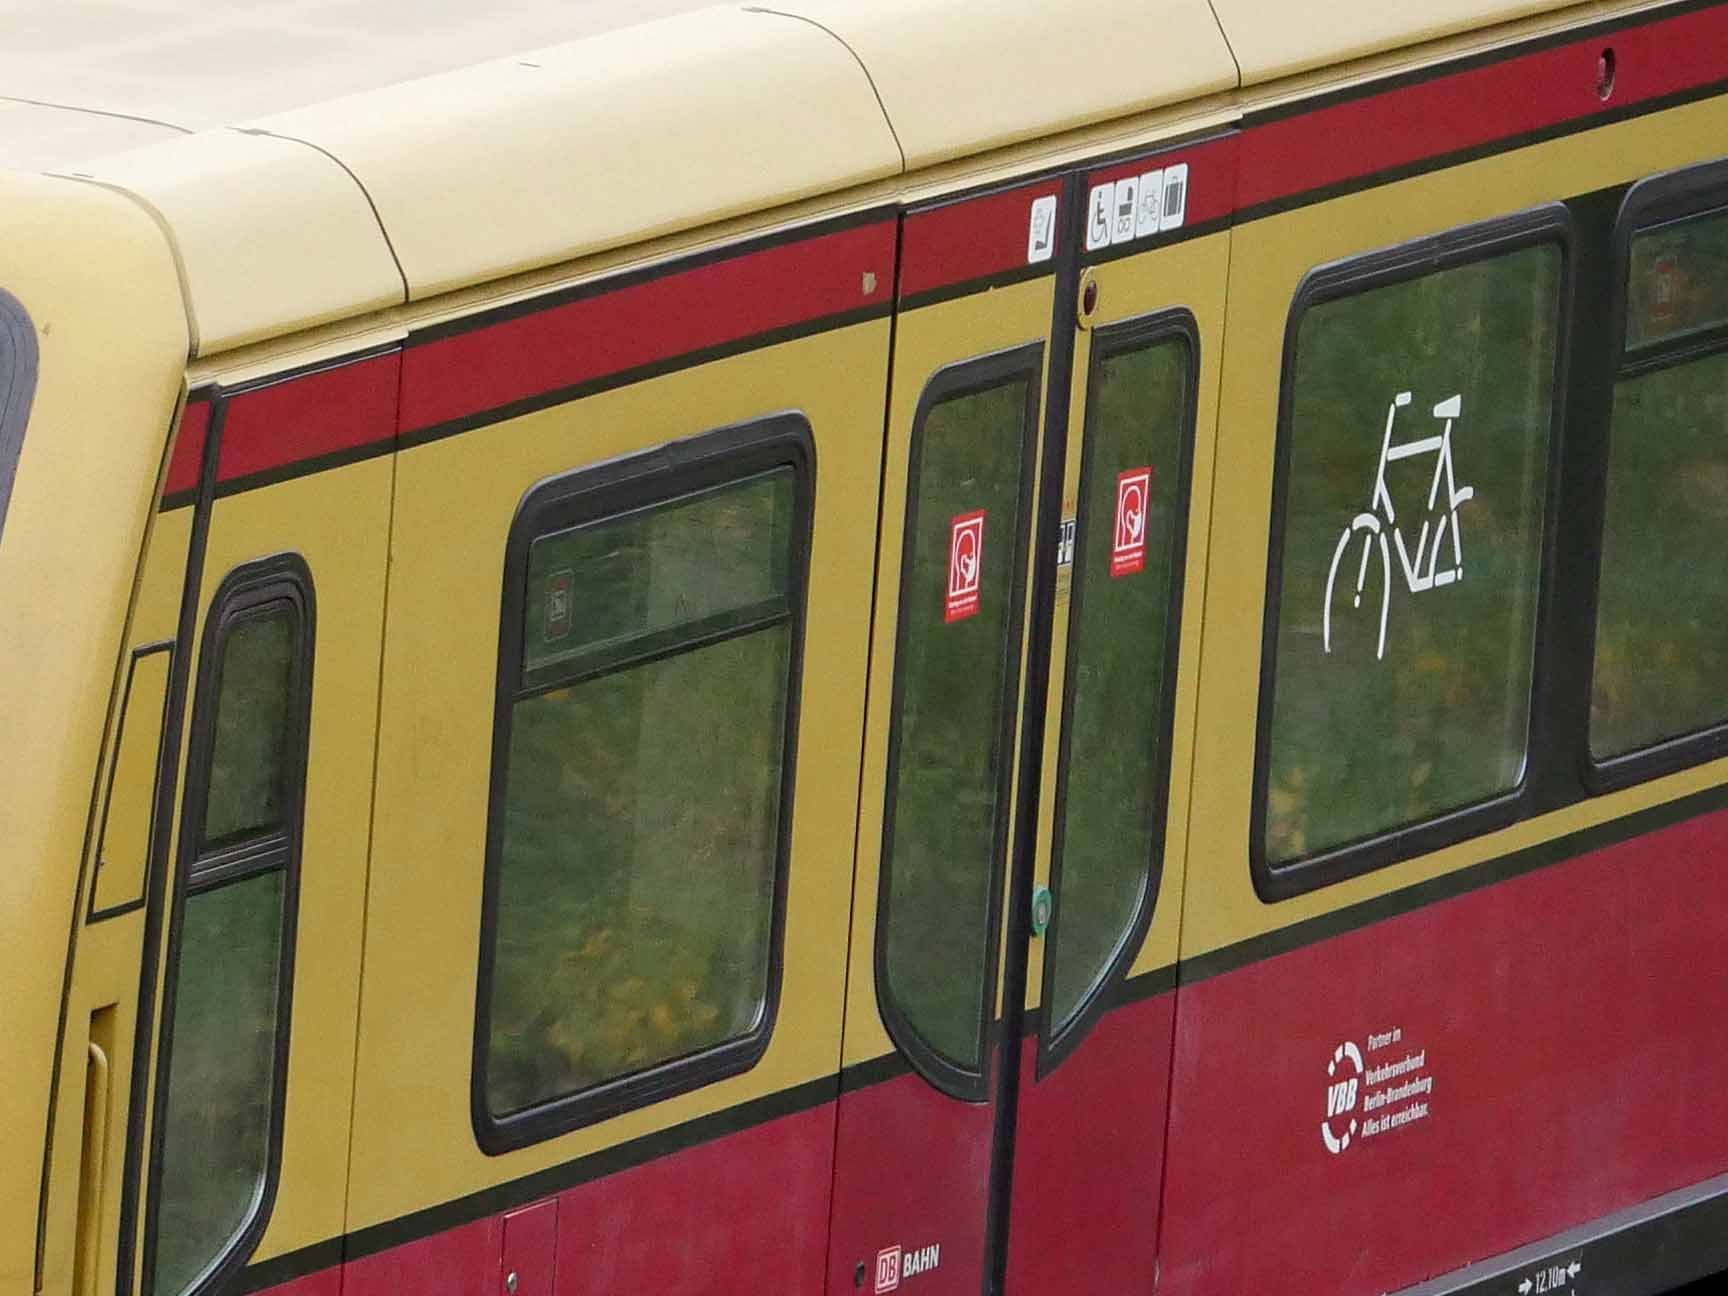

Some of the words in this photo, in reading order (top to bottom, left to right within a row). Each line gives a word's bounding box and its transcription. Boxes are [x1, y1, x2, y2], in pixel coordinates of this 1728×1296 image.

[1327, 1077, 1359, 1117] VBB
[877, 1252, 898, 1288] DB
[902, 1243, 941, 1279] BAHN
